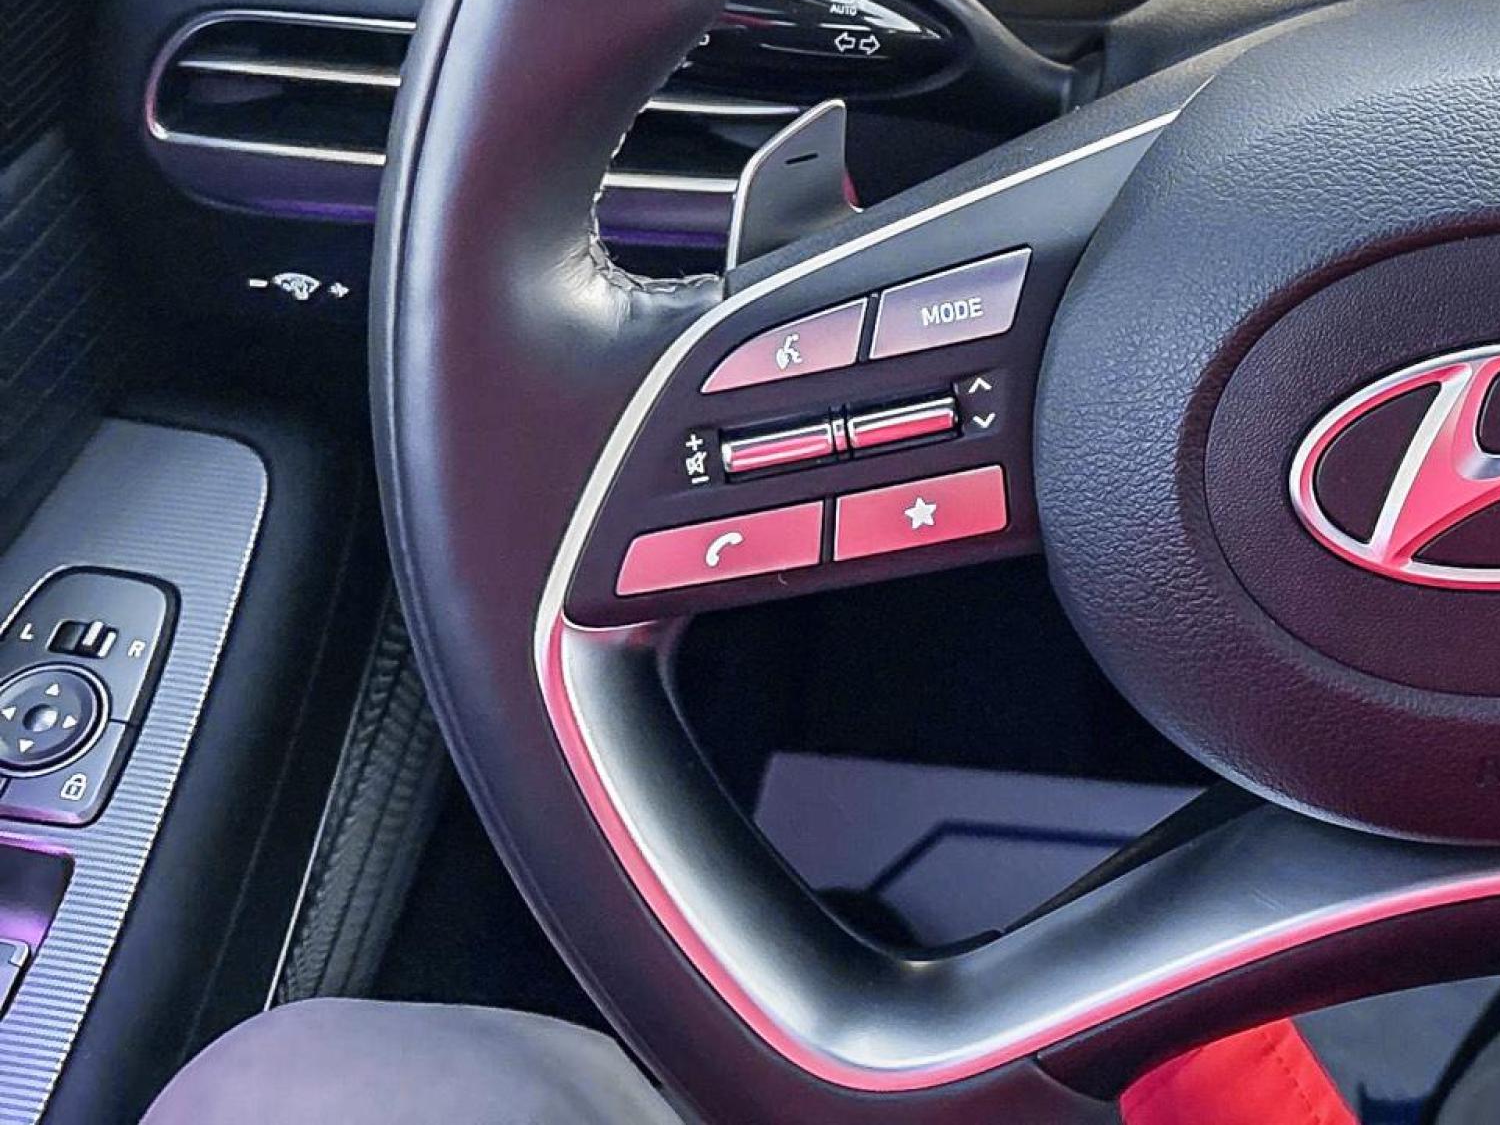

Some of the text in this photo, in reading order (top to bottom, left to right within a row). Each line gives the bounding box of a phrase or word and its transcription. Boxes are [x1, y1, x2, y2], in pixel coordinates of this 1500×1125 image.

[829, 3, 857, 16] AUTO
[920, 297, 984, 326] MODE
[19, 622, 33, 640] L
[128, 639, 146, 658] R
